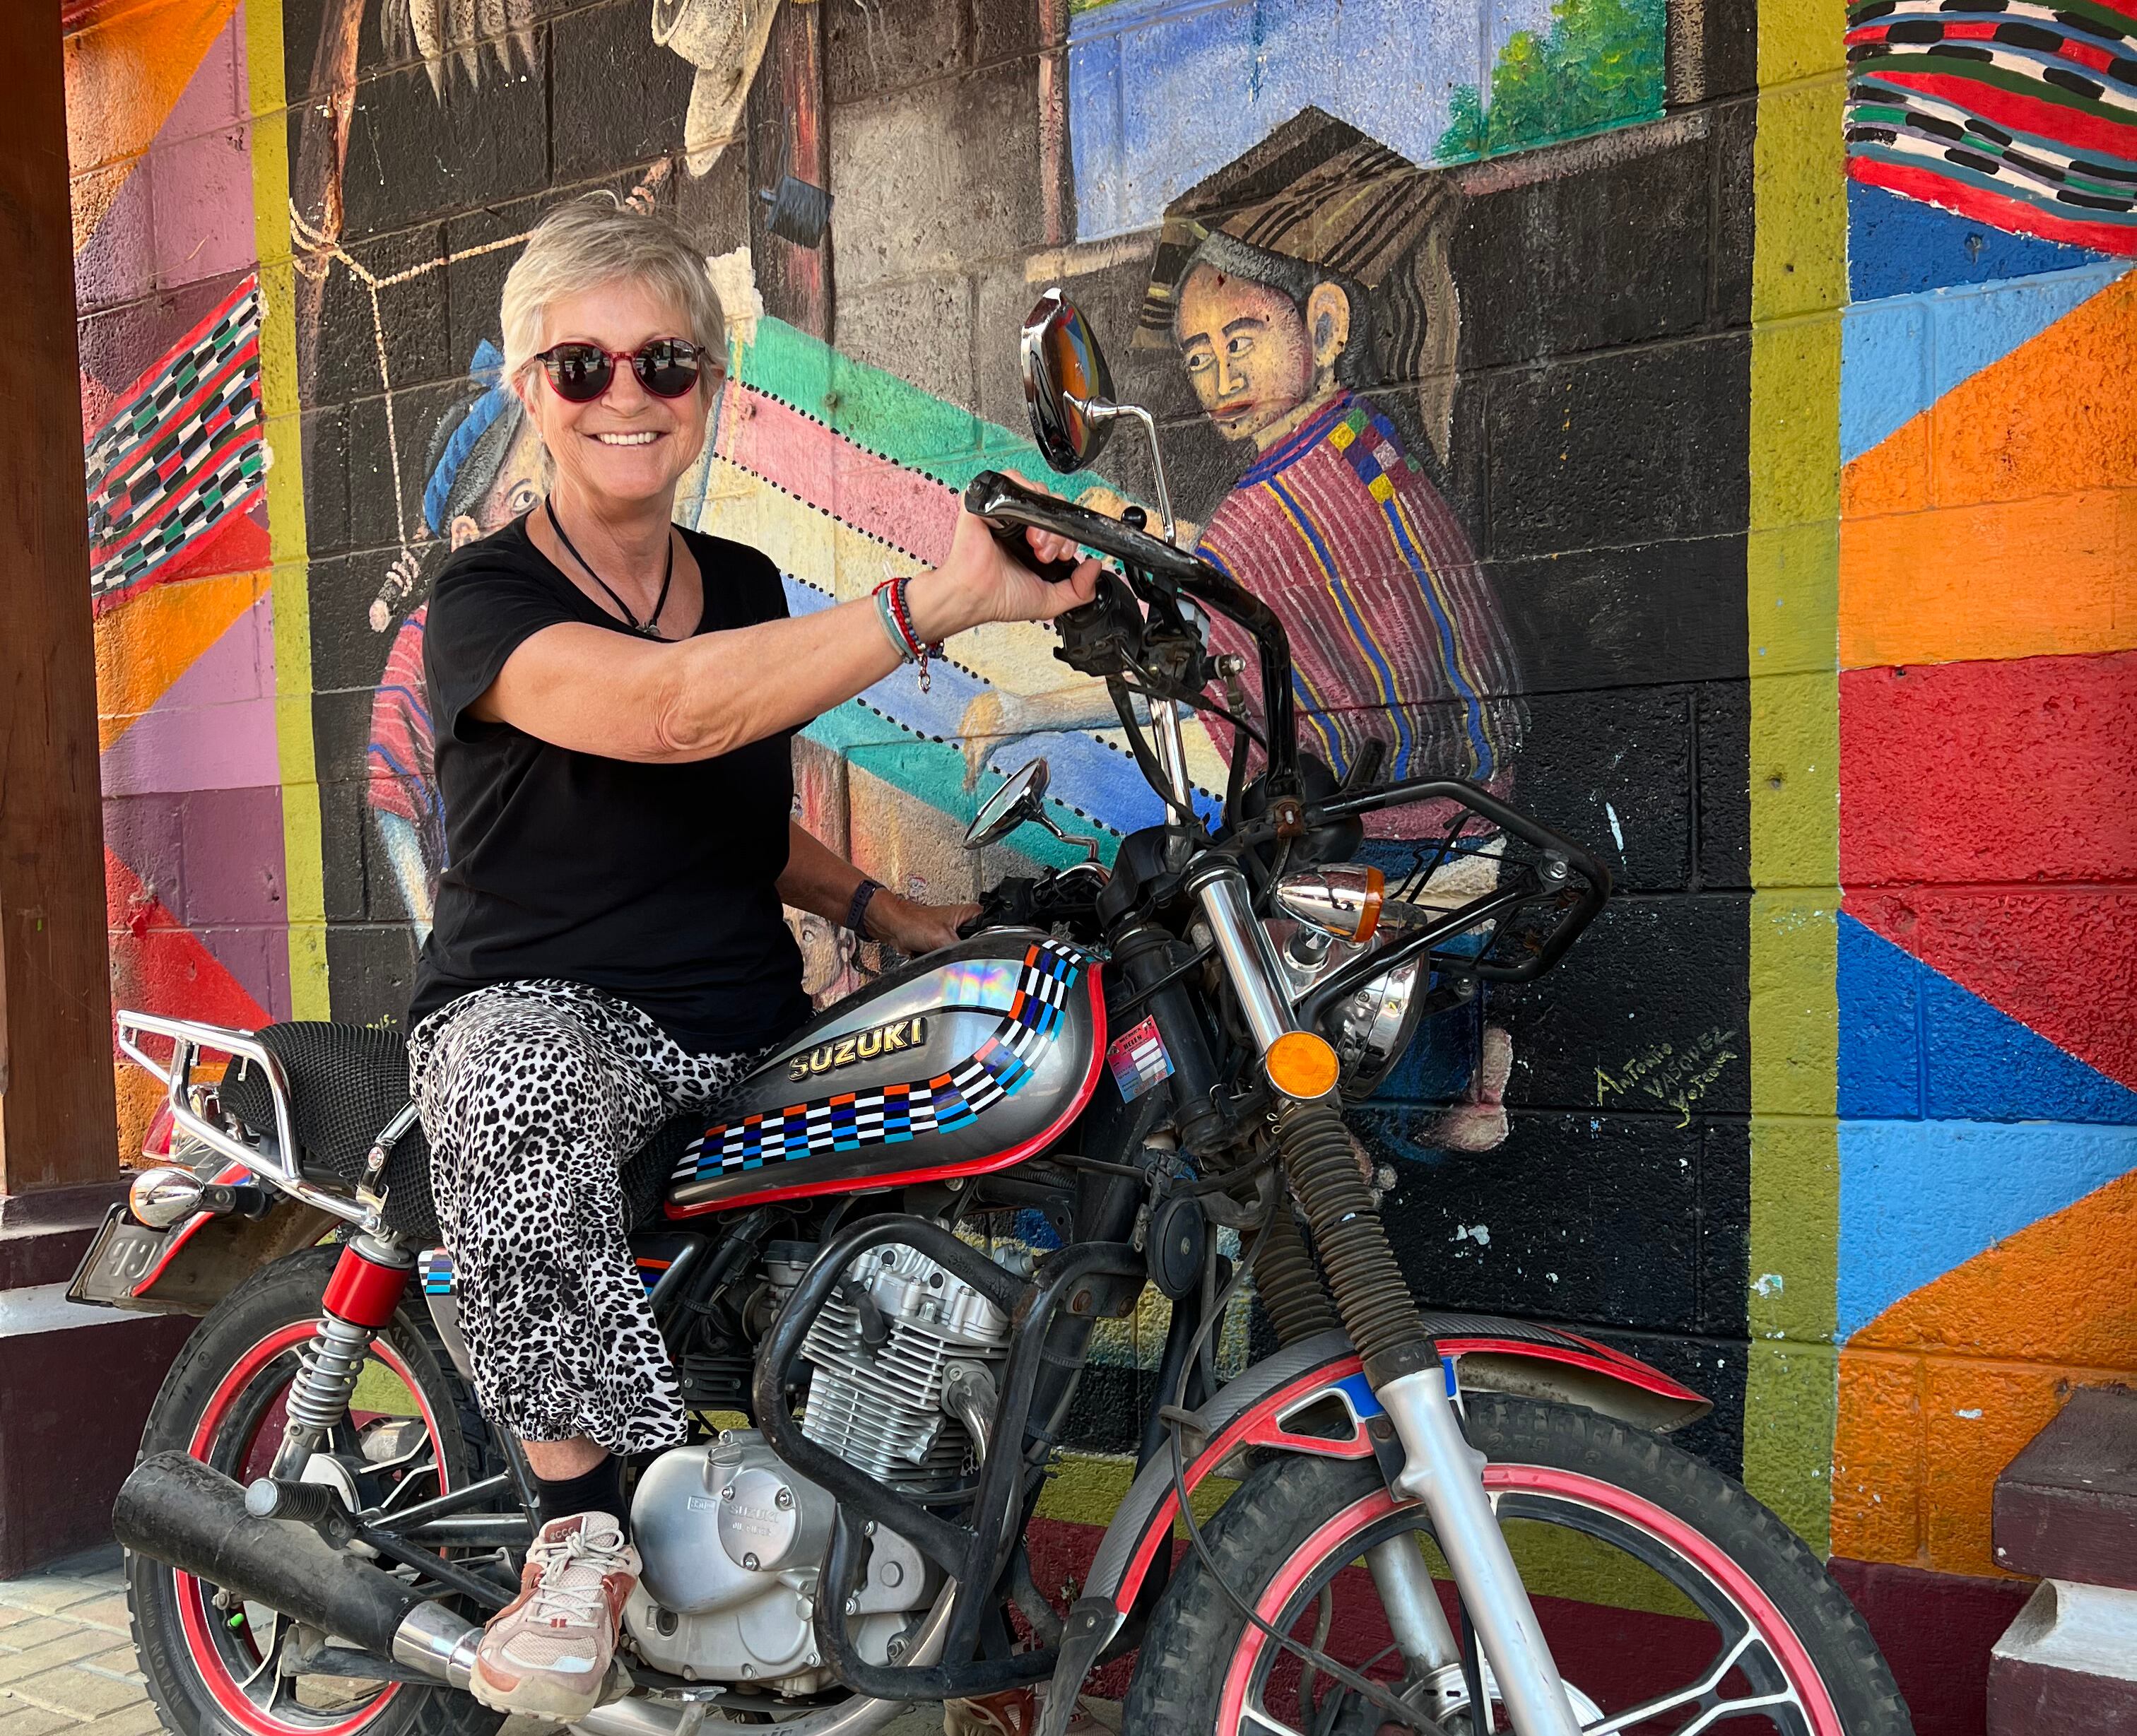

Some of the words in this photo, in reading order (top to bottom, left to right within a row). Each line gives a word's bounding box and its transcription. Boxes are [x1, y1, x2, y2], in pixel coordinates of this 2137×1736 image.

[788, 1017, 923, 1082] SUZUKI
[729, 1504, 779, 1523] SUZUKI
[149, 1641, 183, 1708] NYLON
